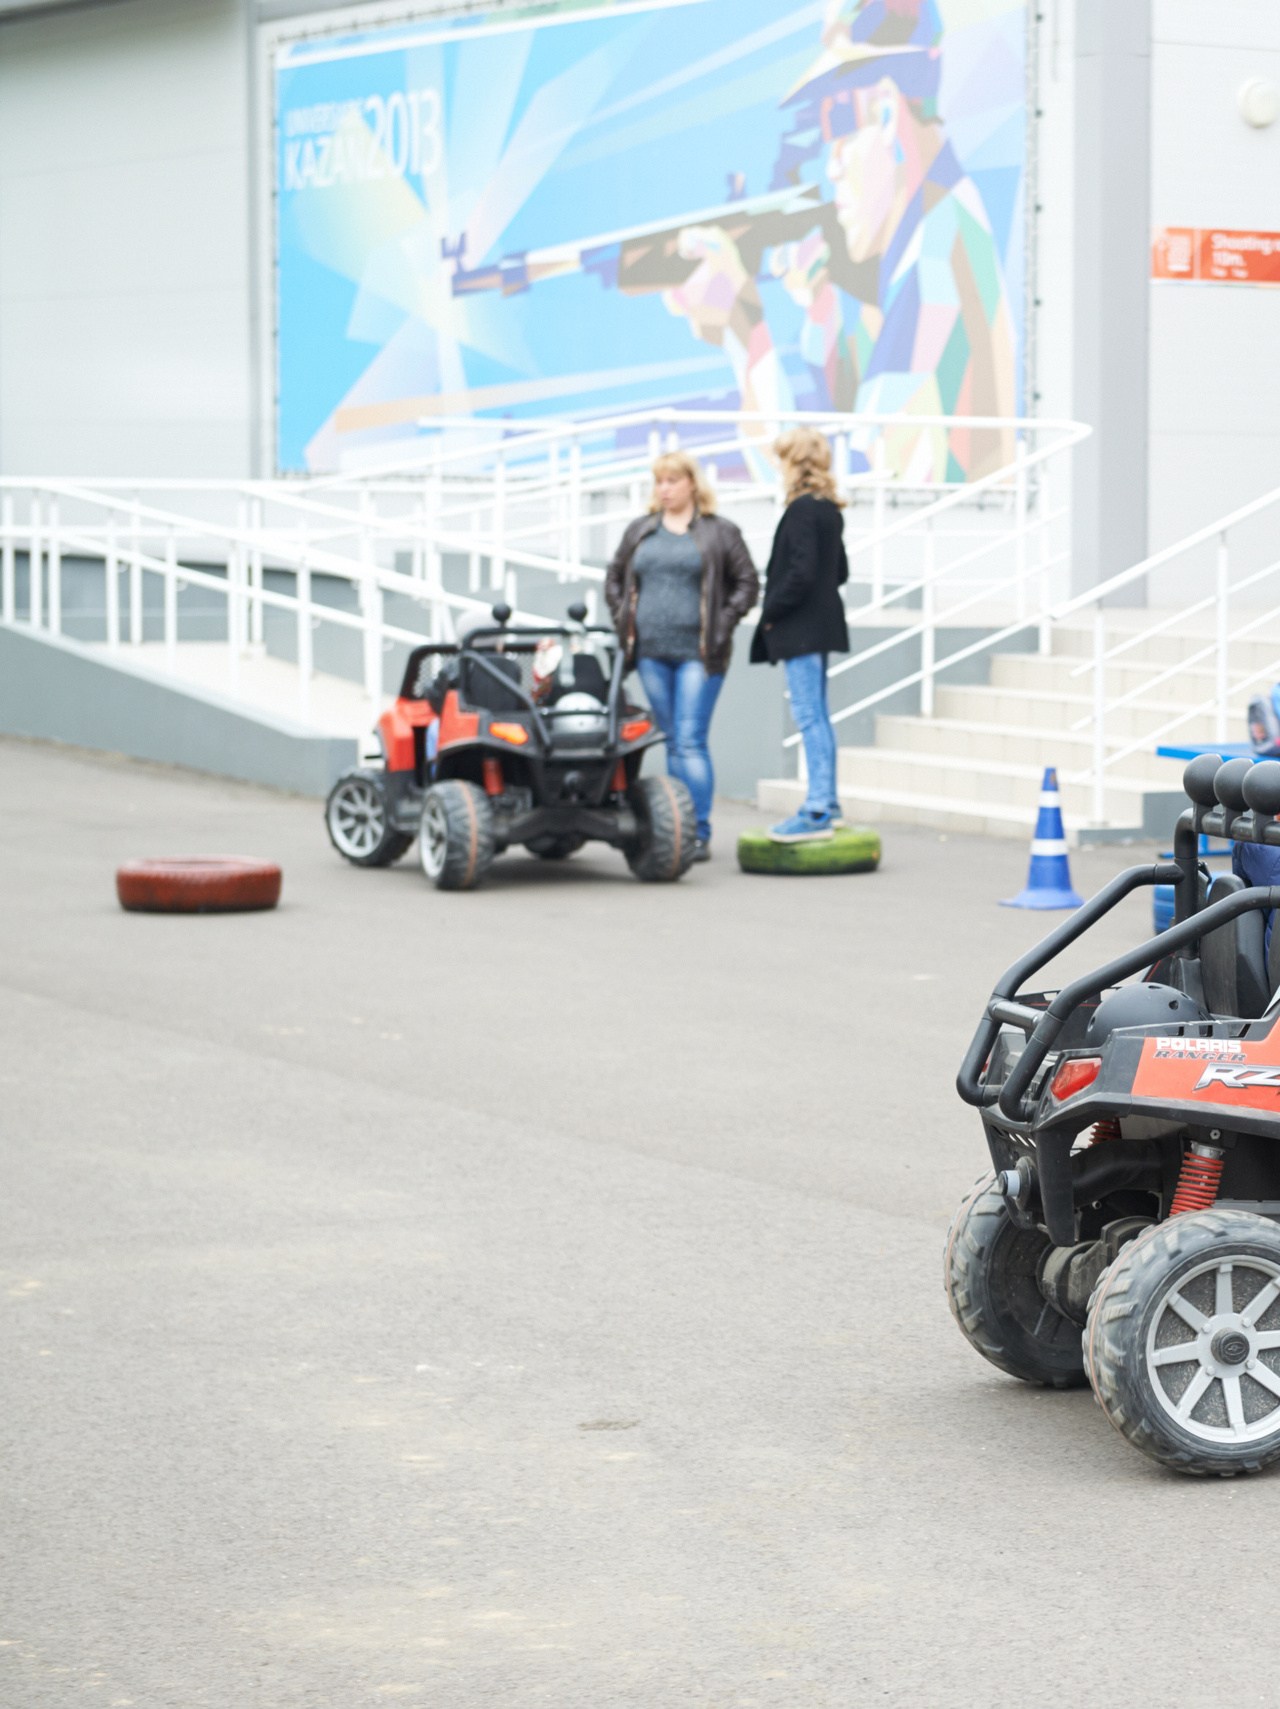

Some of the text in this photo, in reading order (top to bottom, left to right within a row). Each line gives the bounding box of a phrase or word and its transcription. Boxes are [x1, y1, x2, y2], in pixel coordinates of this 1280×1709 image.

[285, 88, 441, 189] KAZAN 2013
[1211, 233, 1272, 256] Shooting
[1156, 1037, 1241, 1053] POLARIS
[1154, 1051, 1247, 1062] RANGER
